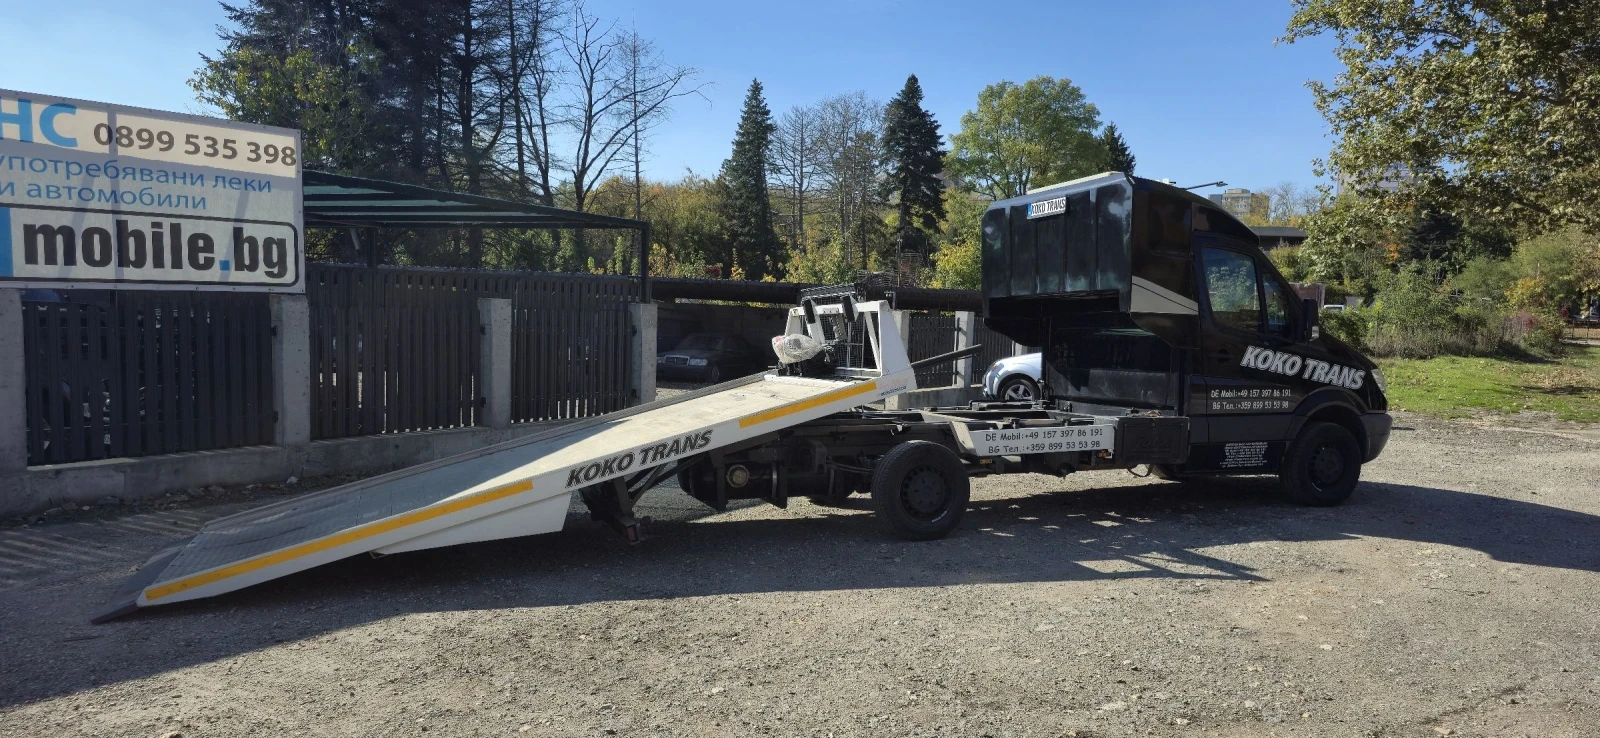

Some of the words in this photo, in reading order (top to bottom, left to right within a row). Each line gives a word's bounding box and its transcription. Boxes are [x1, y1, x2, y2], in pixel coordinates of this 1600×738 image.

[93, 122, 175, 152] 0899
[184, 133, 238, 160] 535
[246, 141, 297, 167] 398
[212, 175, 272, 193] леки
[26, 183, 207, 210] автомобили
[1031, 202, 1046, 215] KOKO
[1046, 199, 1066, 212] TRANS
[22, 219, 288, 279] mobile.bg
[1240, 345, 1303, 377] KOKO
[1302, 358, 1367, 390] TRANS
[1210, 389, 1219, 398] DE
[1249, 389, 1260, 398] 157
[1261, 389, 1272, 398] 397
[1273, 389, 1281, 397] 86
[1282, 389, 1292, 397] 191
[1212, 402, 1221, 410] BG
[1252, 402, 1263, 410] 899
[1264, 401, 1272, 409] 53
[1273, 401, 1281, 409] 53
[1281, 401, 1289, 409] 98
[985, 434, 997, 442] DE
[1042, 430, 1057, 439] 157
[1060, 429, 1074, 438] 397
[1077, 428, 1087, 437] 86
[1090, 428, 1103, 437] 191
[988, 446, 1000, 454] BG
[1048, 442, 1063, 451] 899
[1066, 441, 1076, 449] 53
[1078, 440, 1088, 449] 53
[1090, 440, 1101, 448] 98
[565, 452, 635, 489] KOKO
[638, 429, 714, 469] TRANS
